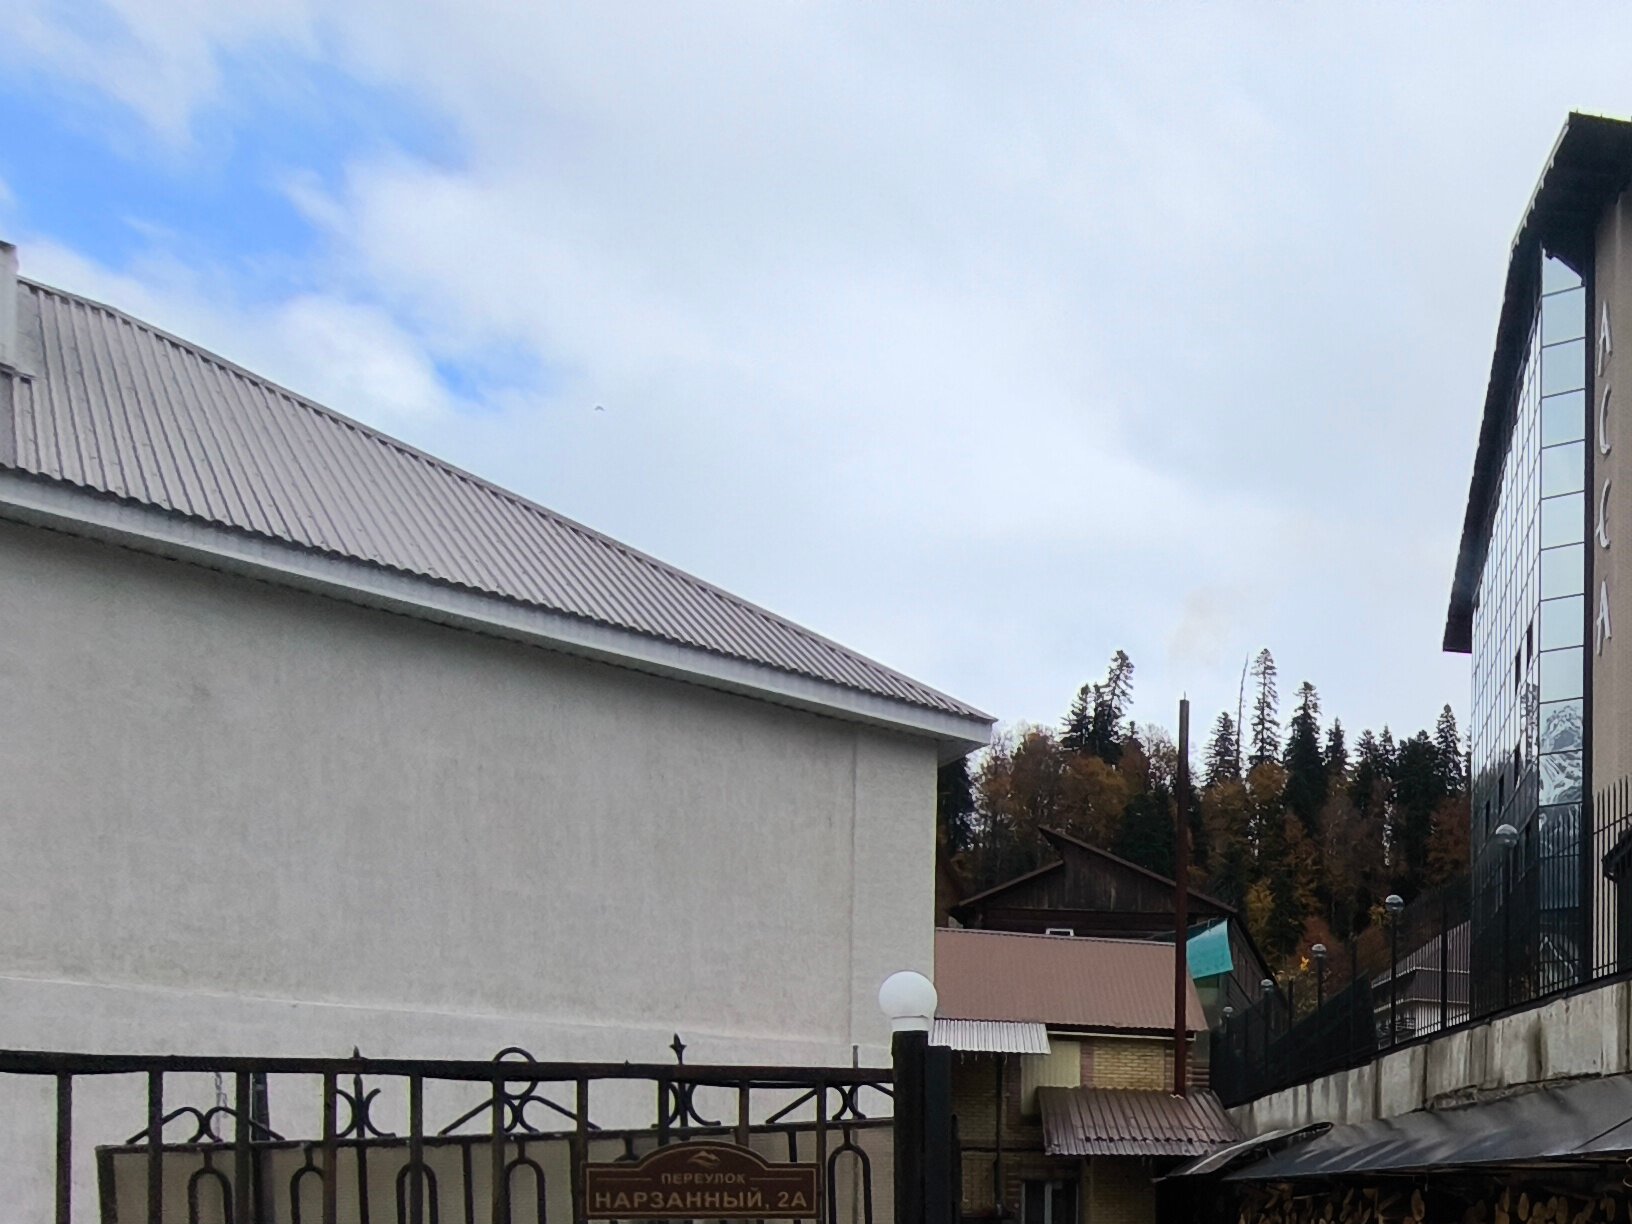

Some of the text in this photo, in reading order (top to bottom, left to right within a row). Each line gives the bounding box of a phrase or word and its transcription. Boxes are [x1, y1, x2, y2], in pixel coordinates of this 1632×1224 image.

[661, 1172, 746, 1185] ПЕРЕУЛОК
[594, 1187, 808, 1210] НАРЗАННЫЙ, 2А
